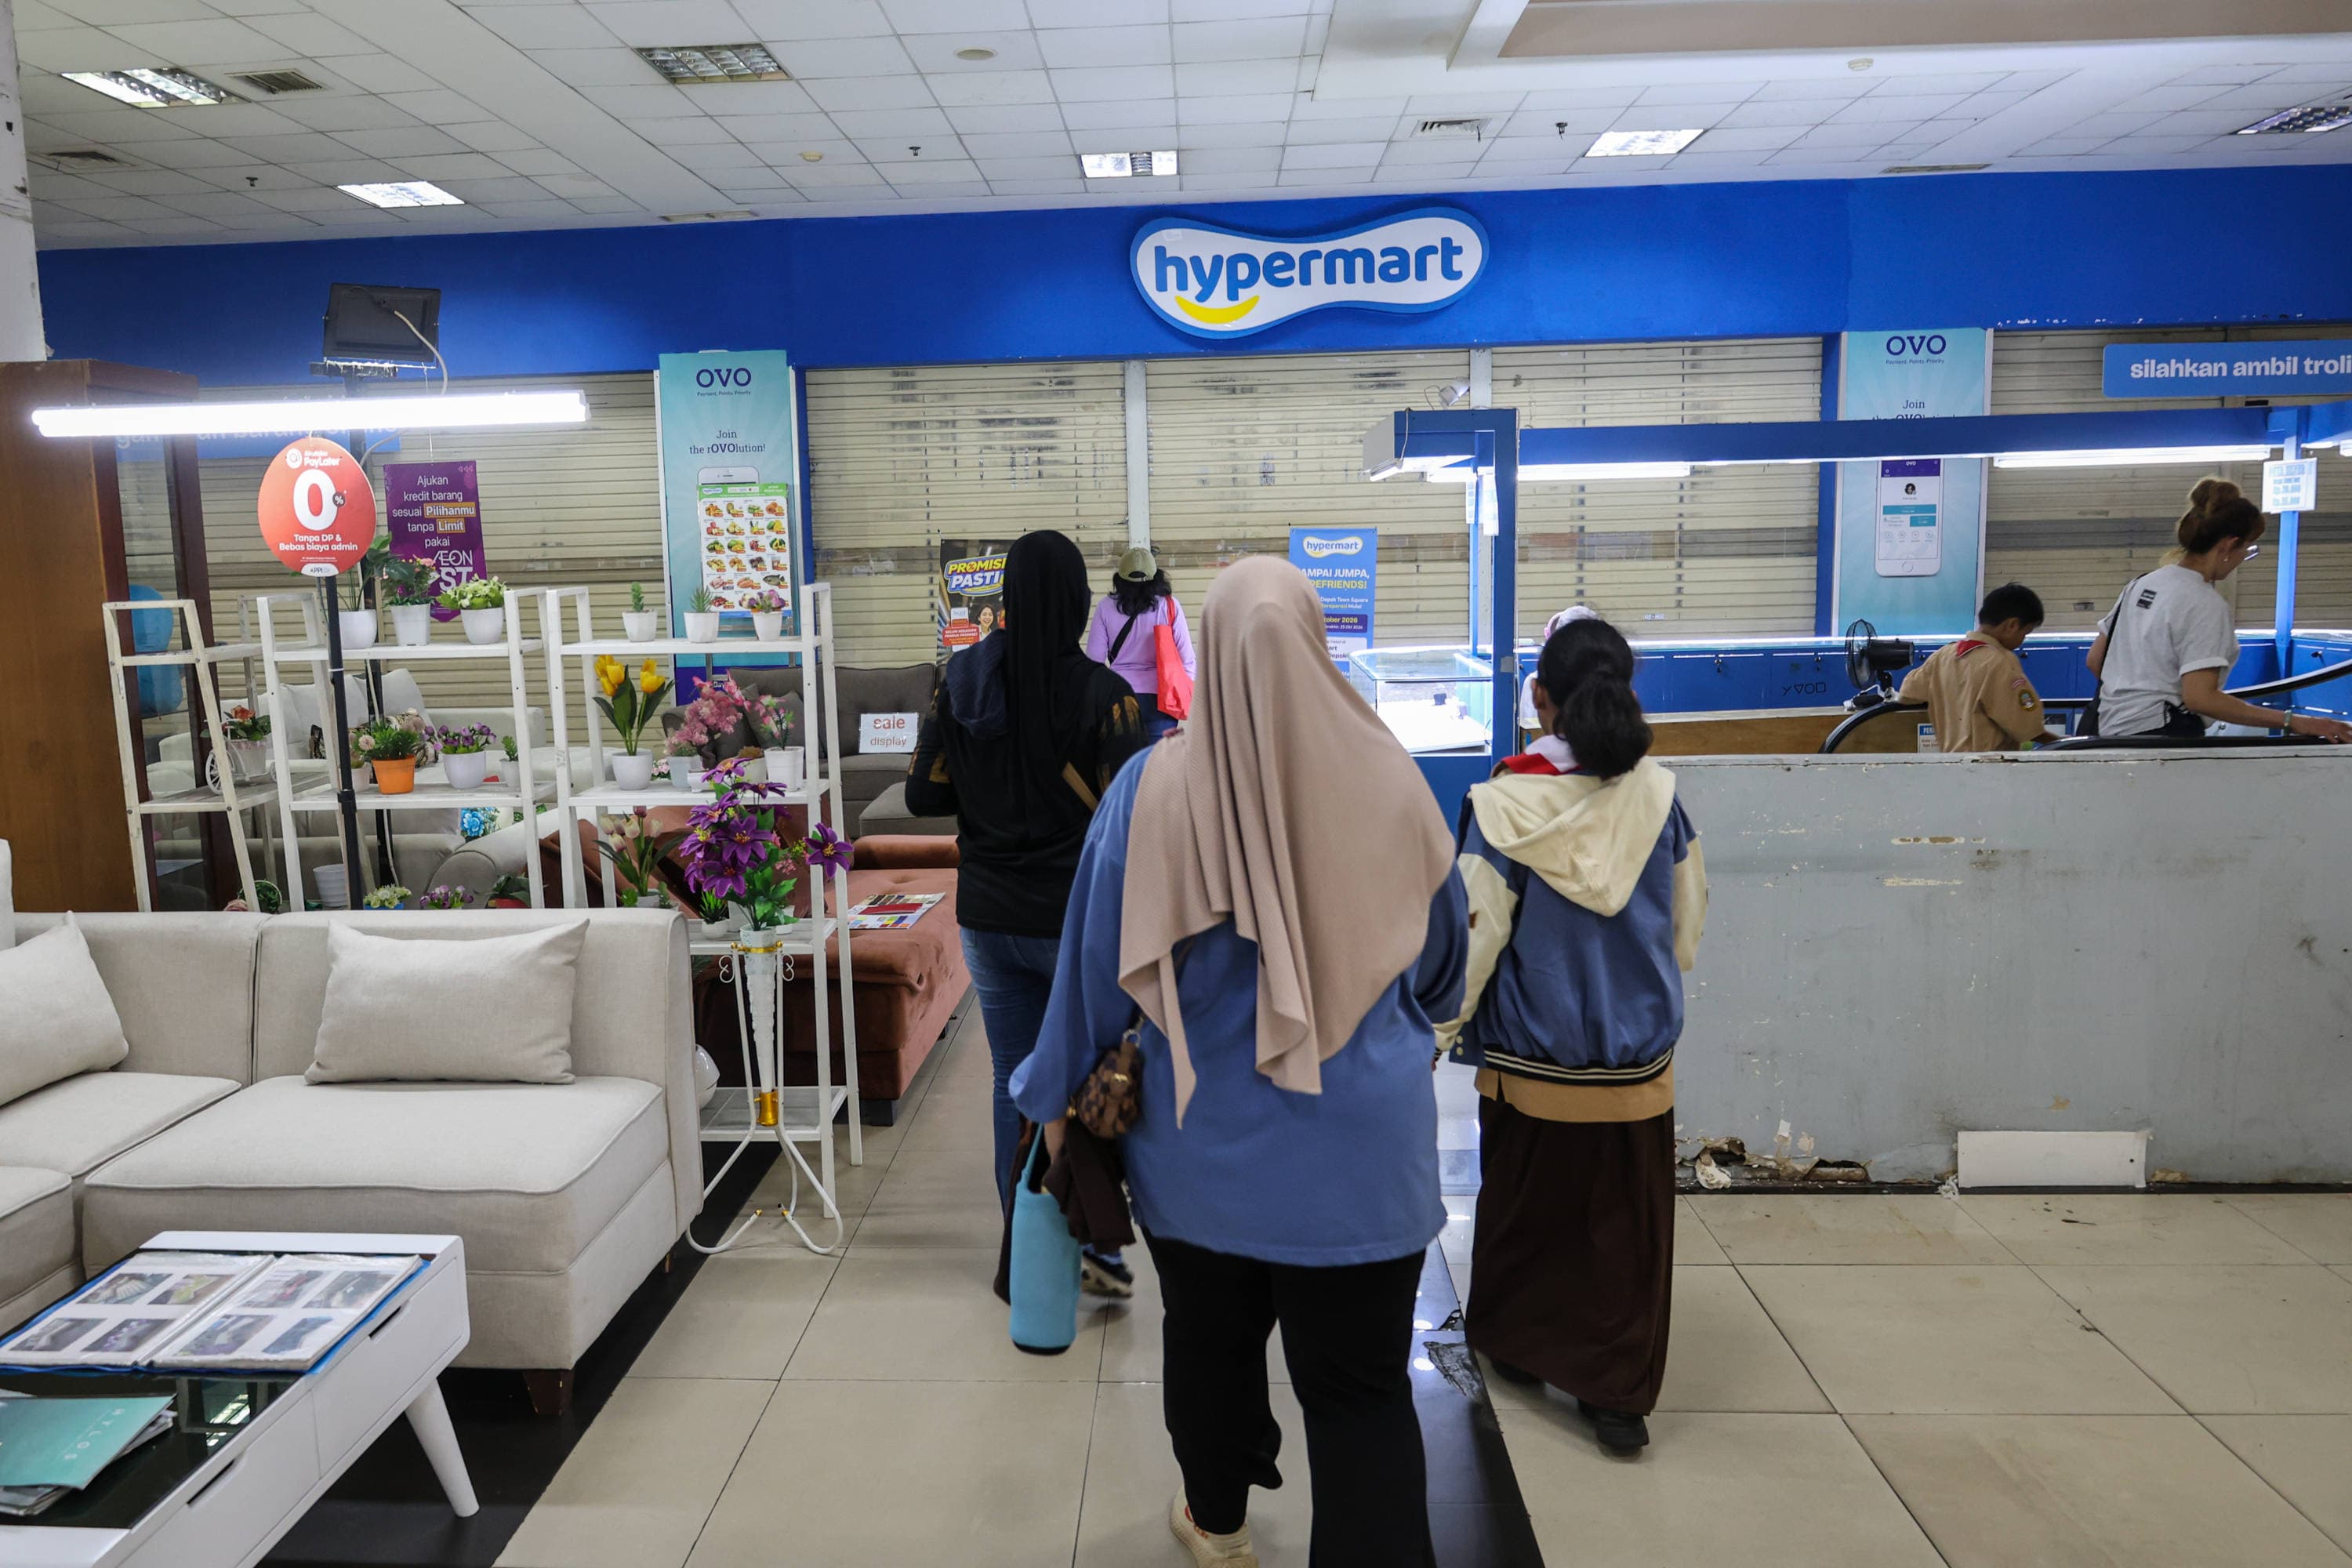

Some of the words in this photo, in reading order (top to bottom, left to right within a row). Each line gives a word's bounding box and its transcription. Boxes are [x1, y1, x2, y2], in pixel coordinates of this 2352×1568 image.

[1155, 237, 1463, 303] hypermart
[1886, 334, 1947, 356] OVO
[2130, 358, 2227, 379] silahkan
[2233, 356, 2298, 376] ambil
[696, 367, 752, 388] OVO
[1902, 400, 1926, 408] Join
[716, 430, 737, 439] Join
[690, 445, 705, 454] the
[707, 443, 766, 453] rOVOlution!
[303, 457, 340, 468] PayLater
[417, 475, 448, 488] Ajukan
[404, 492, 430, 502] kredit
[432, 491, 463, 502] barang
[392, 508, 423, 517] sesuai
[426, 506, 474, 516] Pilihanmu
[408, 523, 434, 533] tanpa
[438, 521, 464, 531] Limit
[307, 543, 329, 552] biaya
[331, 542, 358, 550] admin
[425, 536, 450, 548] pakai
[1306, 541, 1359, 551] hypermart
[1301, 568, 1332, 578] AMPAI
[1334, 568, 1370, 579] JUMPA,
[951, 571, 1000, 588] PASTI
[873, 715, 905, 729] sale
[870, 736, 906, 747] display
